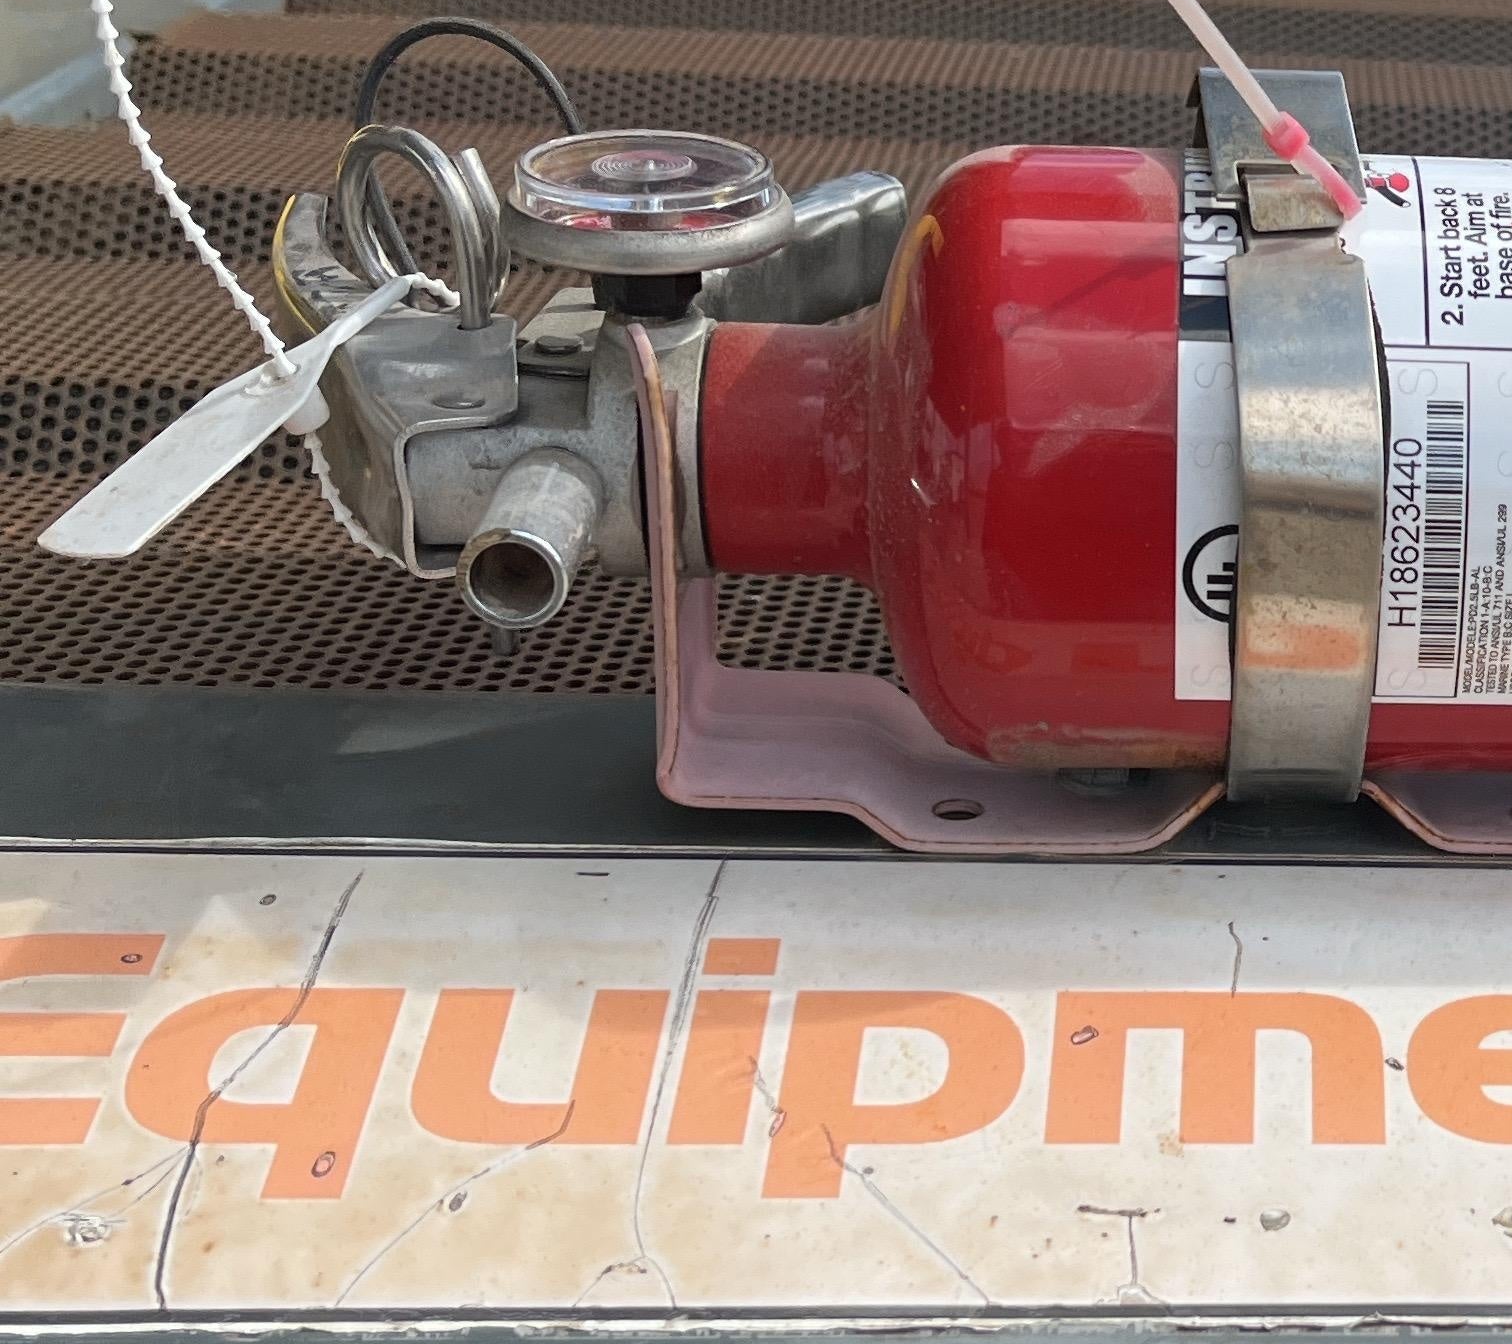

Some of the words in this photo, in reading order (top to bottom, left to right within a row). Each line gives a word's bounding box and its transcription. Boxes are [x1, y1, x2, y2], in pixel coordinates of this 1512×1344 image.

[1433, 187, 1456, 195] 8
[1462, 193, 1484, 206] at
[1489, 193, 1512, 219] fire.
[1435, 199, 1460, 239] back
[1464, 211, 1488, 245] Aim
[1439, 246, 1463, 298] Start
[1466, 252, 1490, 299] feet.
[1441, 305, 1463, 326] 2.
[1387, 438, 1423, 627] H18623440
